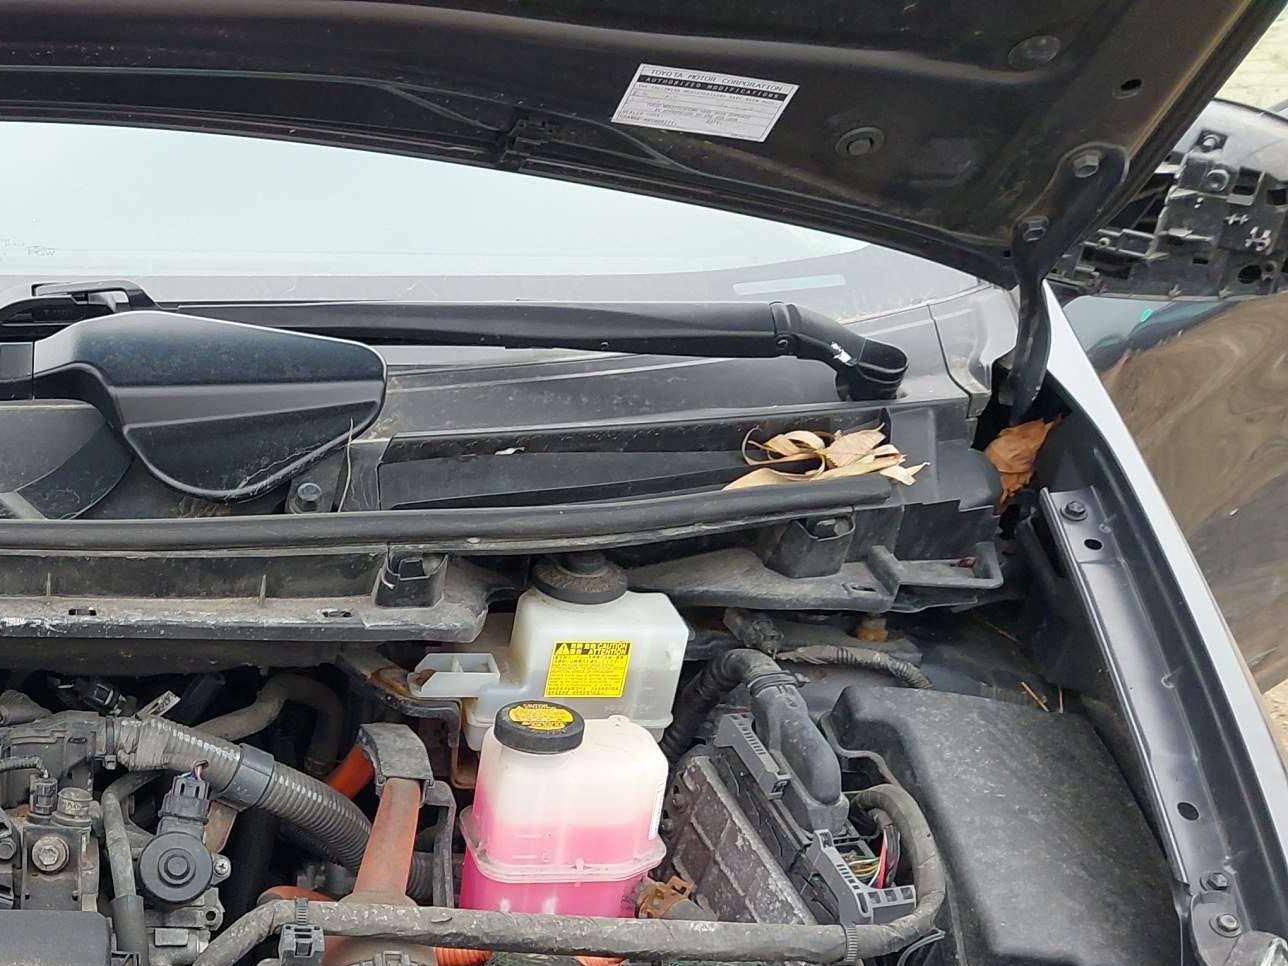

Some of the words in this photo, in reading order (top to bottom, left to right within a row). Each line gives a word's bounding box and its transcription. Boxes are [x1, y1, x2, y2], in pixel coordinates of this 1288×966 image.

[645, 77, 702, 88] AUTHORIZED
[706, 84, 780, 99] MODIFICATIONS
[650, 69, 683, 78] TOYOTA
[687, 73, 717, 83] MOTOR
[721, 78, 784, 92] CORPORATION
[588, 648, 627, 656] ATTENTION
